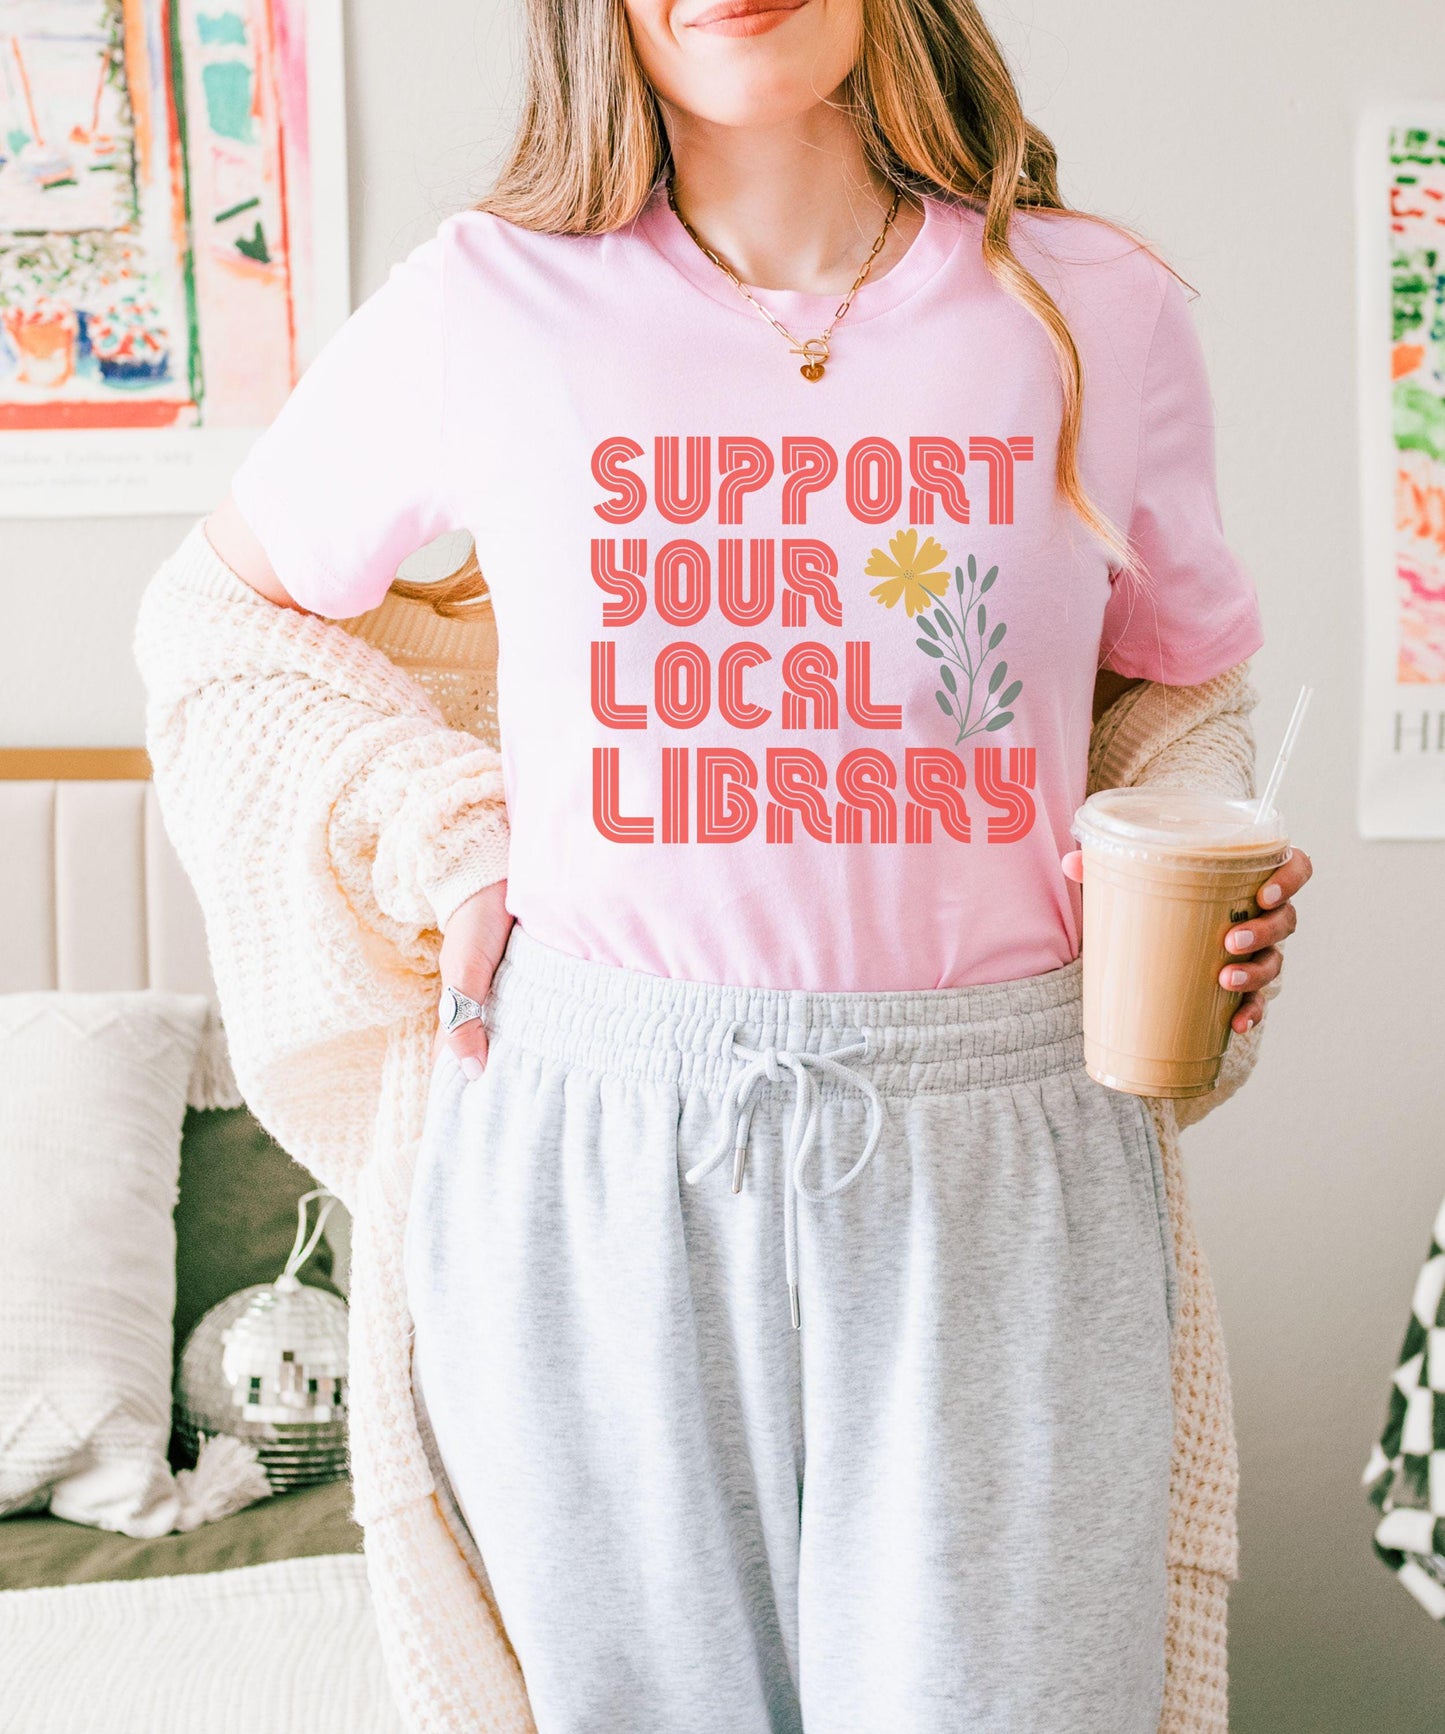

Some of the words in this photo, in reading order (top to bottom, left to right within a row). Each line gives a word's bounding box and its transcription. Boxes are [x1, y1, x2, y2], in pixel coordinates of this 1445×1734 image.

[591, 437, 1033, 524] SUPPORT
[591, 539, 842, 627] YOUR
[591, 641, 902, 729] LOCAL
[592, 747, 1036, 844] LIBRARY
